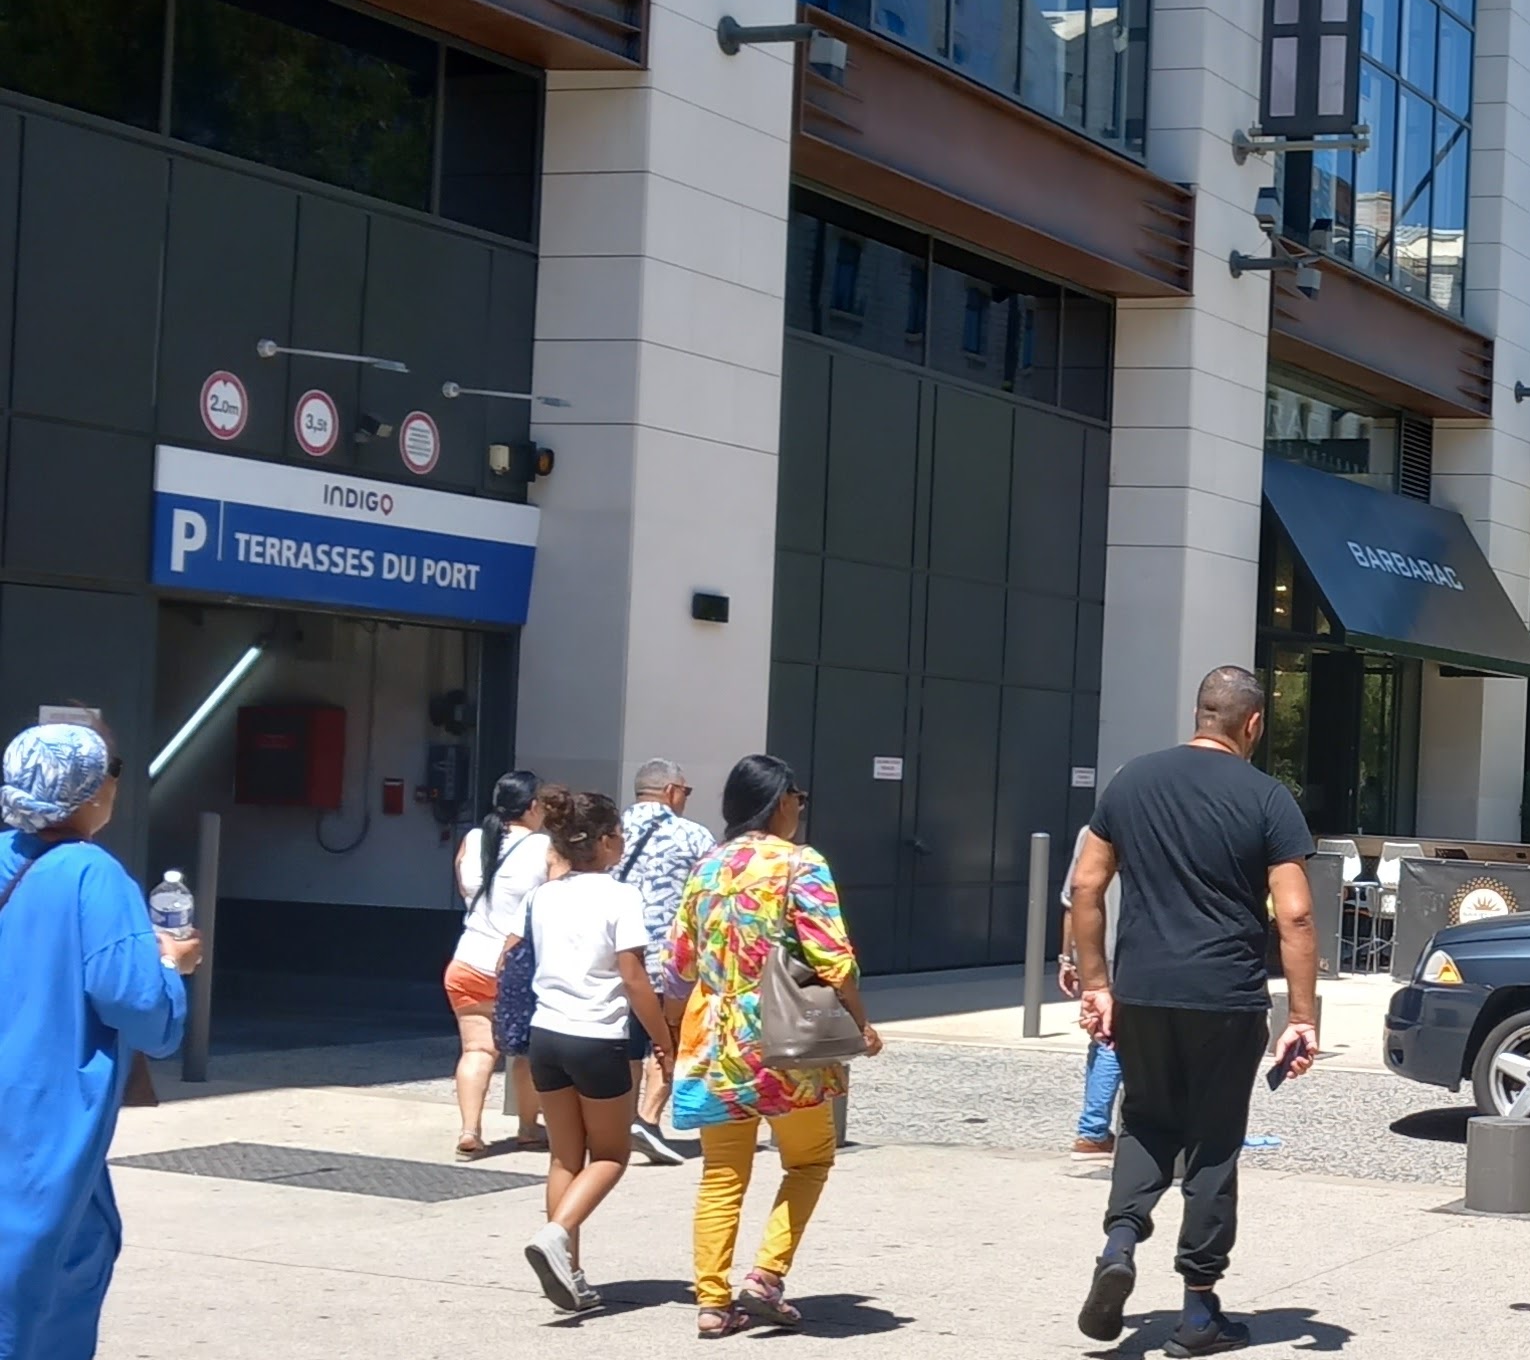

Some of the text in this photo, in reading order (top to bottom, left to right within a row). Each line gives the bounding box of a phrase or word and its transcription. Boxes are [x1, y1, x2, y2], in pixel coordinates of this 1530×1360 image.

[324, 484, 394, 516] INDIGO
[170, 509, 208, 572] P
[234, 532, 480, 590] TERRASSES DU PORT
[1347, 541, 1464, 591] BARBARAC
